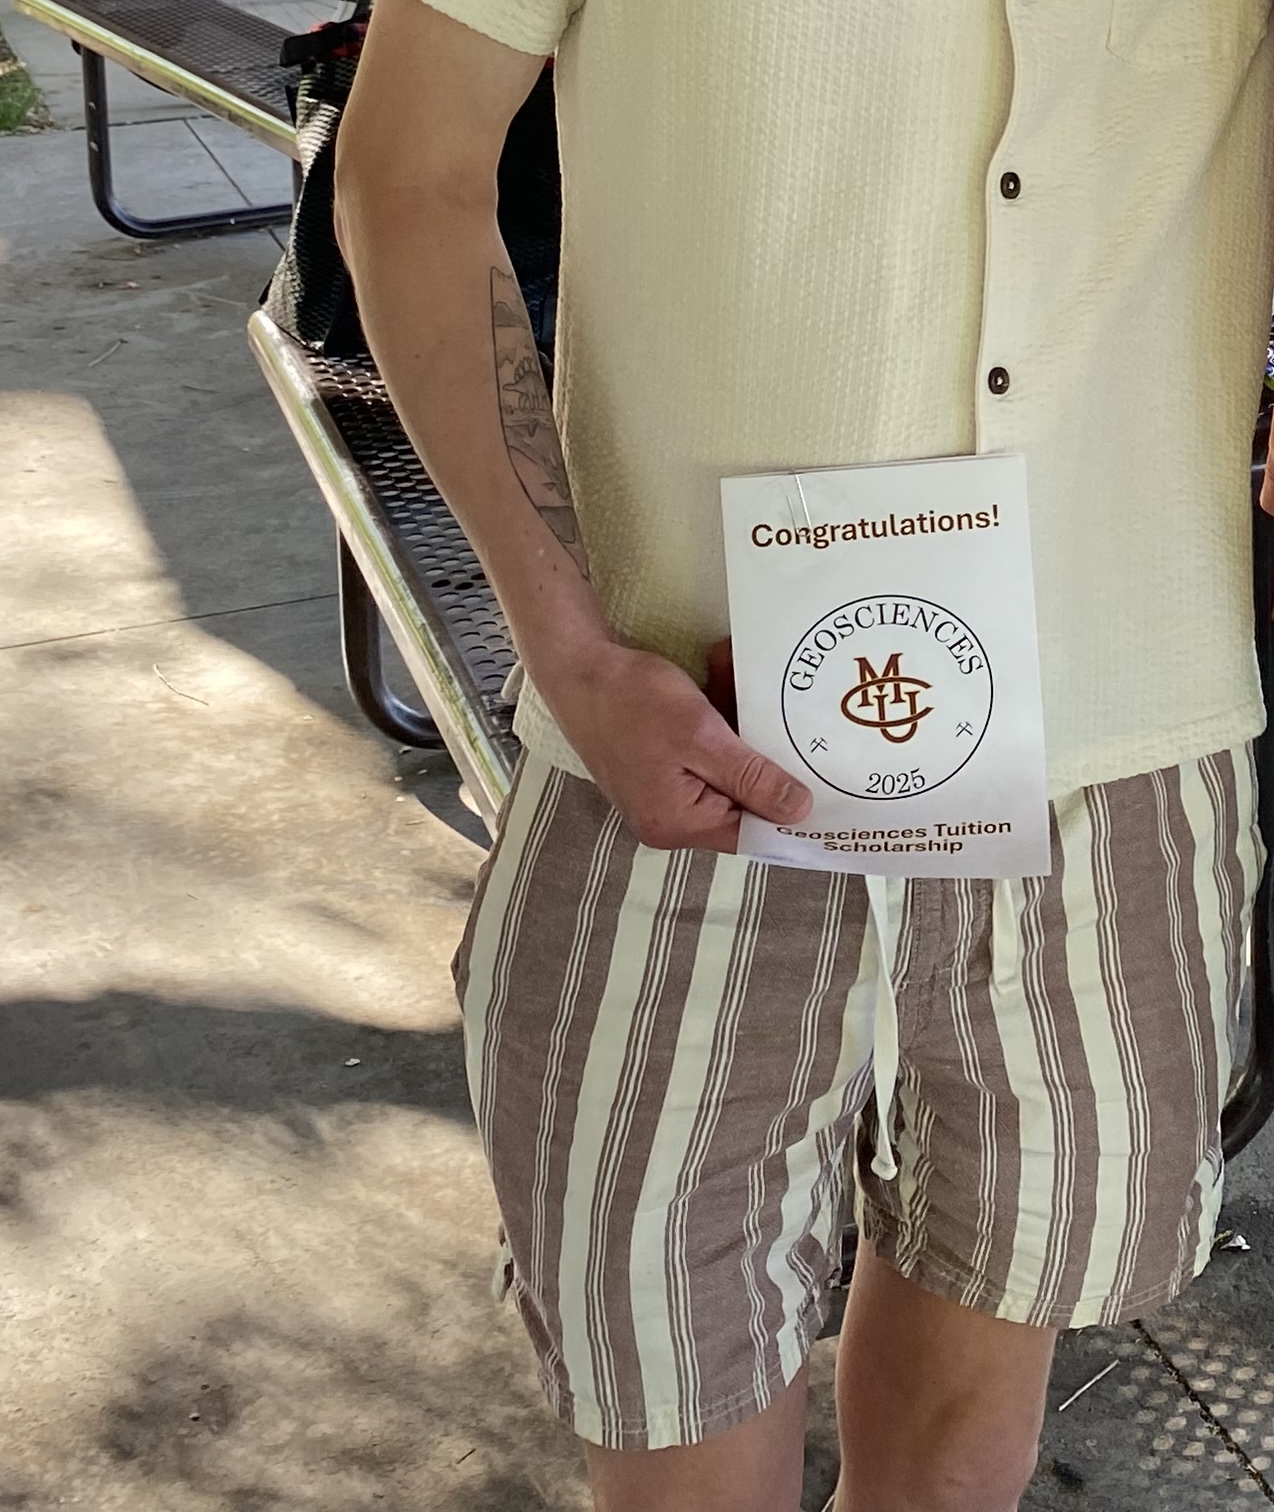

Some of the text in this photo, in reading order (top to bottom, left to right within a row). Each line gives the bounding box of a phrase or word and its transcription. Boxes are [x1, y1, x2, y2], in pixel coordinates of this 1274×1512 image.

[751, 504, 1001, 549] Congratulations!
[789, 602, 984, 693] GEOSCIENCES
[865, 767, 926, 796] 2025
[776, 820, 1012, 841] Geosciences Tuition
[823, 838, 964, 855] Scholarship
